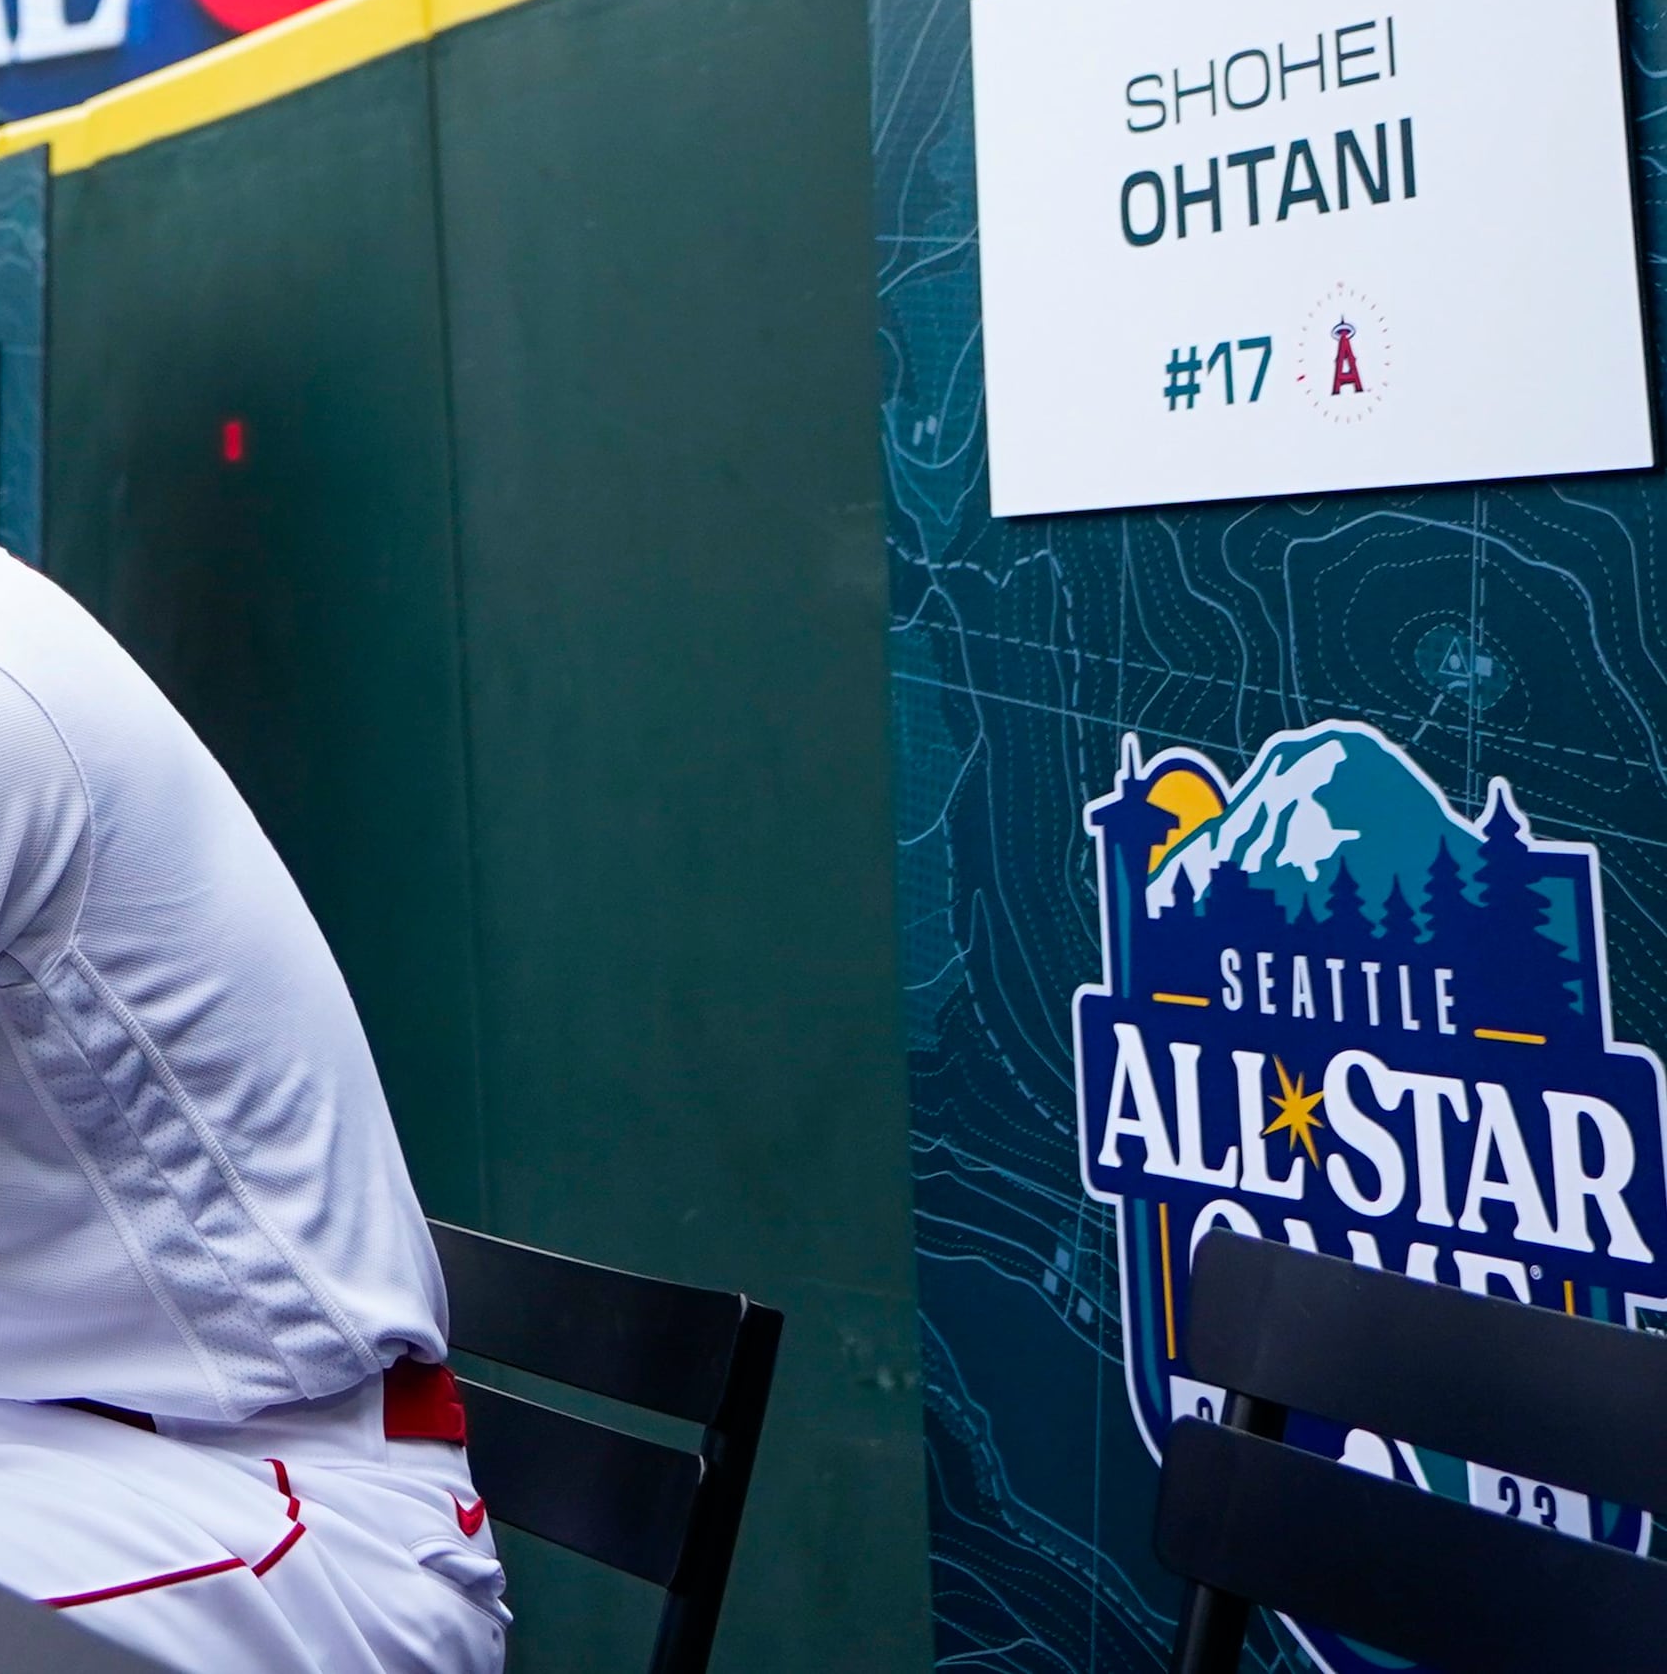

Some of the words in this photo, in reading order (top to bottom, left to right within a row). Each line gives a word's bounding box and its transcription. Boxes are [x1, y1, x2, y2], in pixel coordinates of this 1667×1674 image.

[1124, 16, 1397, 133] SHOHEI
[1120, 118, 1418, 248] OHTANI
[1163, 336, 1273, 412] #17
[1219, 947, 1458, 1035] SEATTLE
[1097, 1022, 1305, 1202] ALL
[1322, 1048, 1655, 1264] STAR
